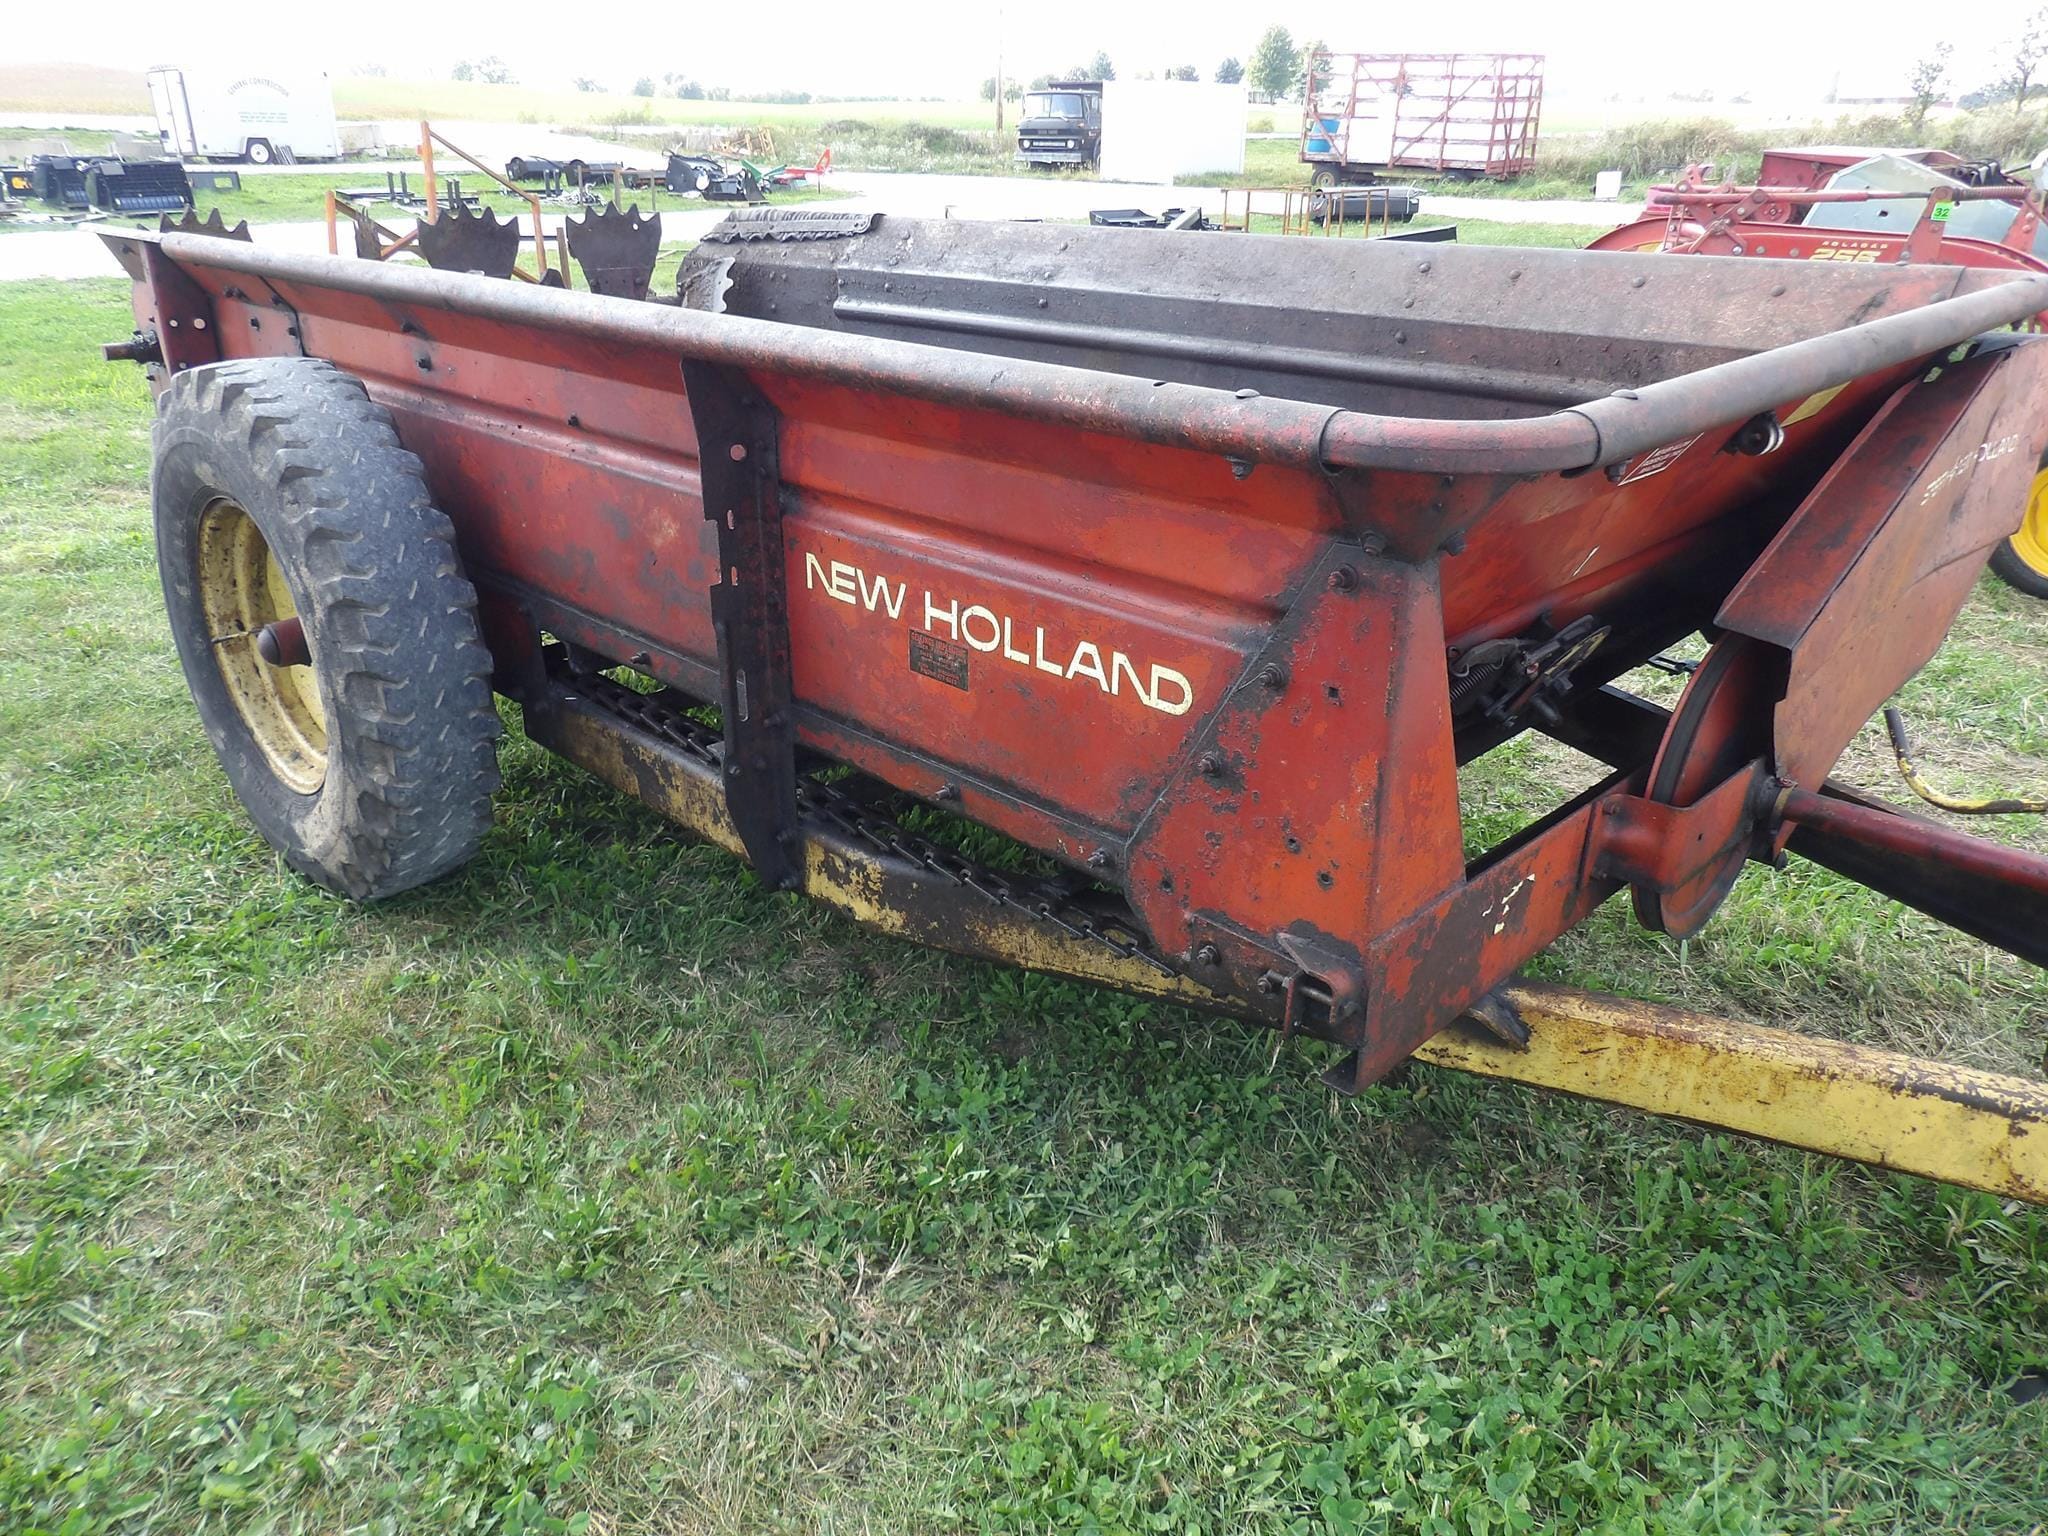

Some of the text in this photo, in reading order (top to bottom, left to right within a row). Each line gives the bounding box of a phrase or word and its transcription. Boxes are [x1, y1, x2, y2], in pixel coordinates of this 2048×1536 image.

[1934, 207, 1950, 218] 32
[805, 552, 1194, 717] NEW HOLLAND
